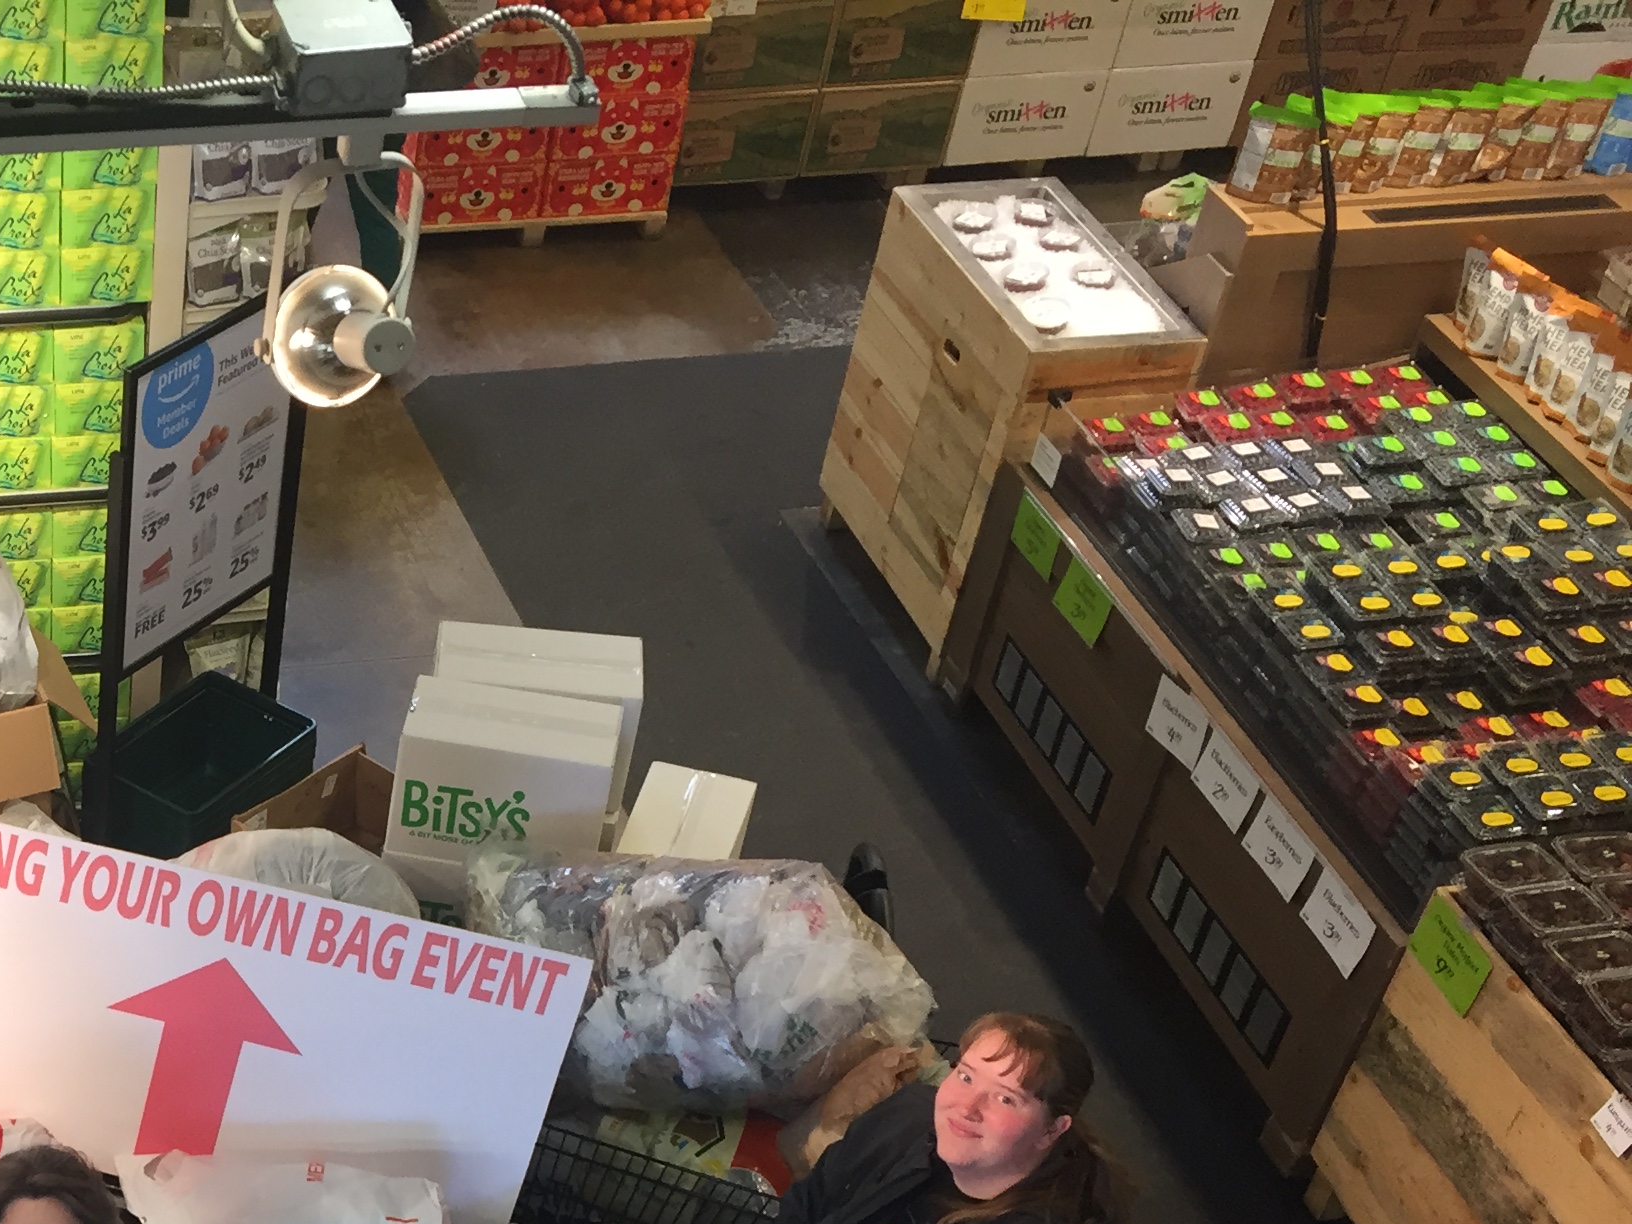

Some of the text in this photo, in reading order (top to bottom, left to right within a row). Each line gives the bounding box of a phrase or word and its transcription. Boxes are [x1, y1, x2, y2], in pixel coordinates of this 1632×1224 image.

[1010, 10, 1093, 34] smitten
[1157, 1, 1239, 25] smitten
[986, 101, 1067, 124] smitten
[1132, 93, 1211, 115] smitten
[17, 200, 36, 225] La
[114, 195, 131, 220] La
[91, 213, 136, 243] Croix
[18, 259, 37, 285] La
[112, 254, 130, 279] La
[91, 272, 135, 299] Croix
[12, 339, 30, 364] La
[104, 335, 121, 358] La
[83, 352, 126, 378] Croix
[158, 354, 201, 394] prime
[218, 358, 258, 387] Featured
[219, 354, 238, 371] This
[17, 393, 34, 416] La
[157, 399, 196, 427] Member
[163, 418, 189, 439] Deals
[11, 448, 29, 470] La
[14, 518, 32, 540] La
[134, 609, 166, 639] FREE
[59, 846, 179, 928] YOUR
[187, 888, 306, 955] OWN
[308, 907, 406, 980] BAG
[410, 930, 570, 1015] EVENT
